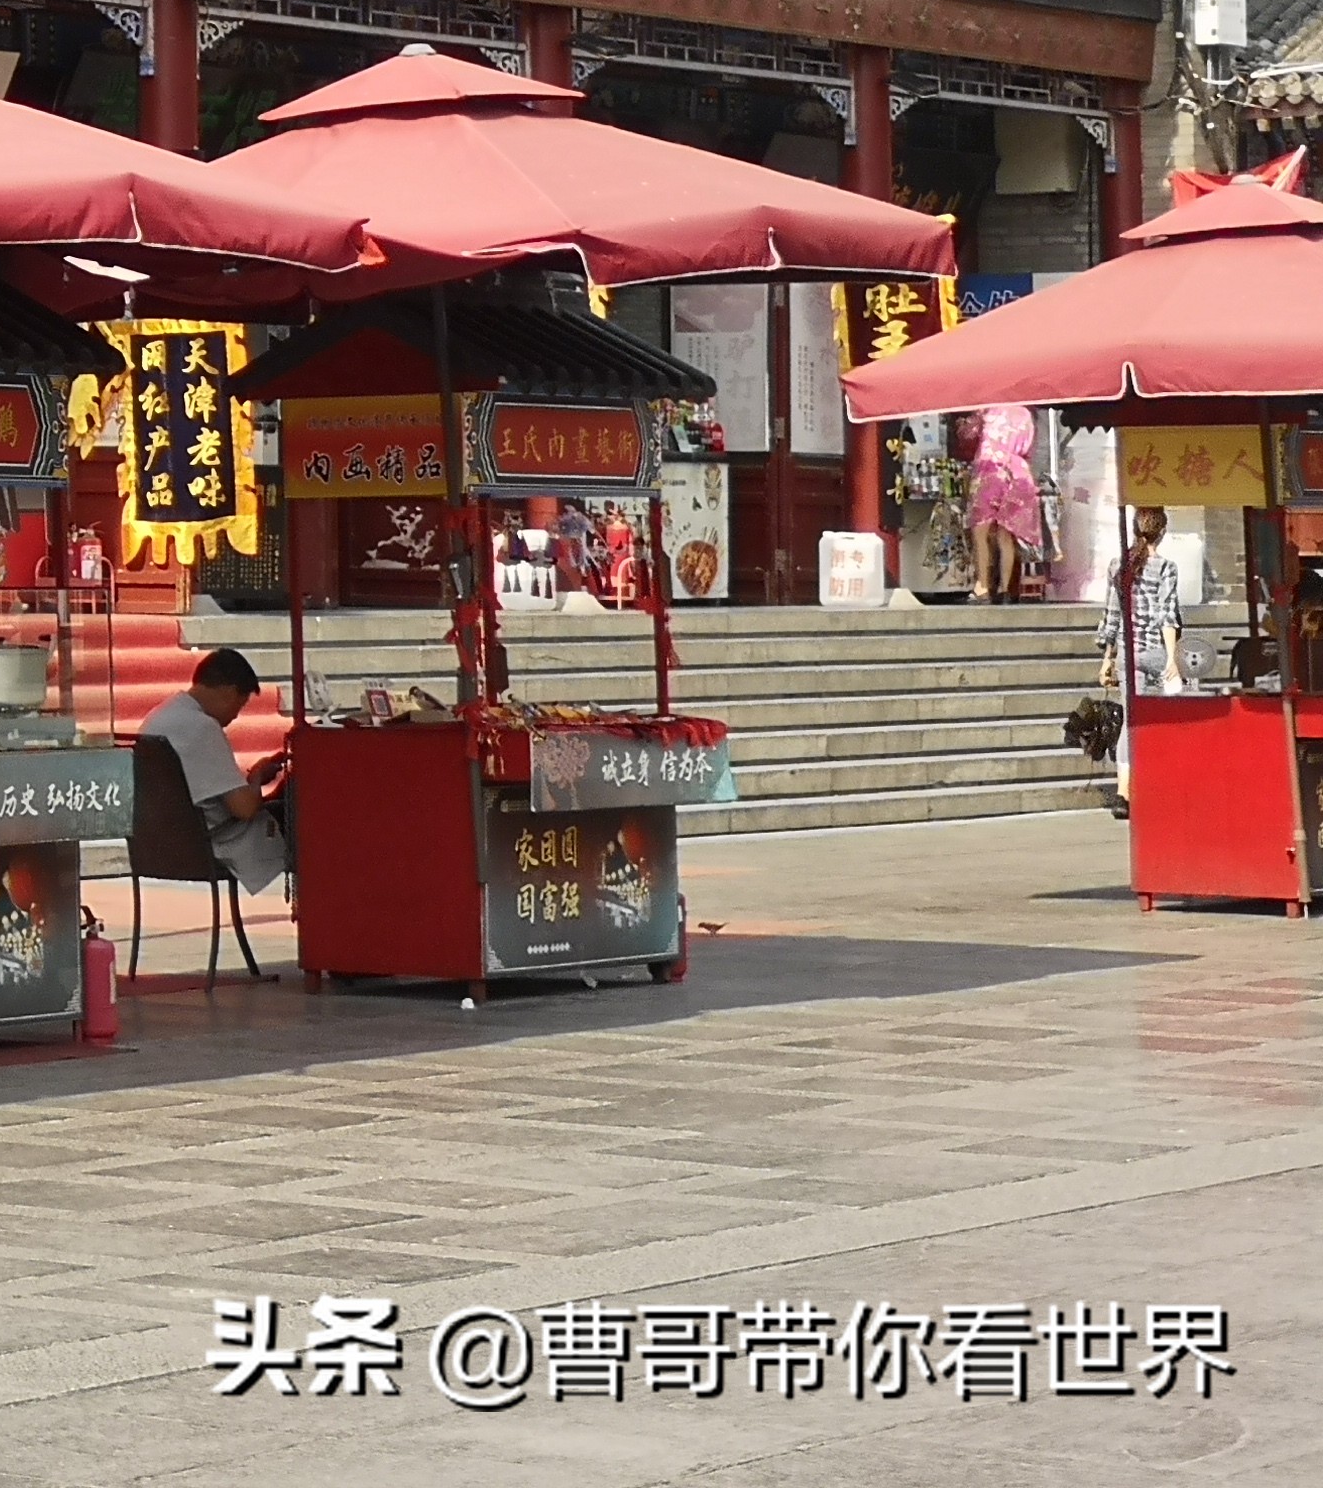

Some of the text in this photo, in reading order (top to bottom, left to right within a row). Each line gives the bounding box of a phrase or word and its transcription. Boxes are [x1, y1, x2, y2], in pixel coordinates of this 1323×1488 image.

[181, 337, 227, 508] 天津老味
[601, 748, 713, 787] 诚立身 信为本
[47, 781, 122, 815] 弘扬文化
[513, 823, 580, 872] 家团圆
[515, 878, 581, 925] 国富强
